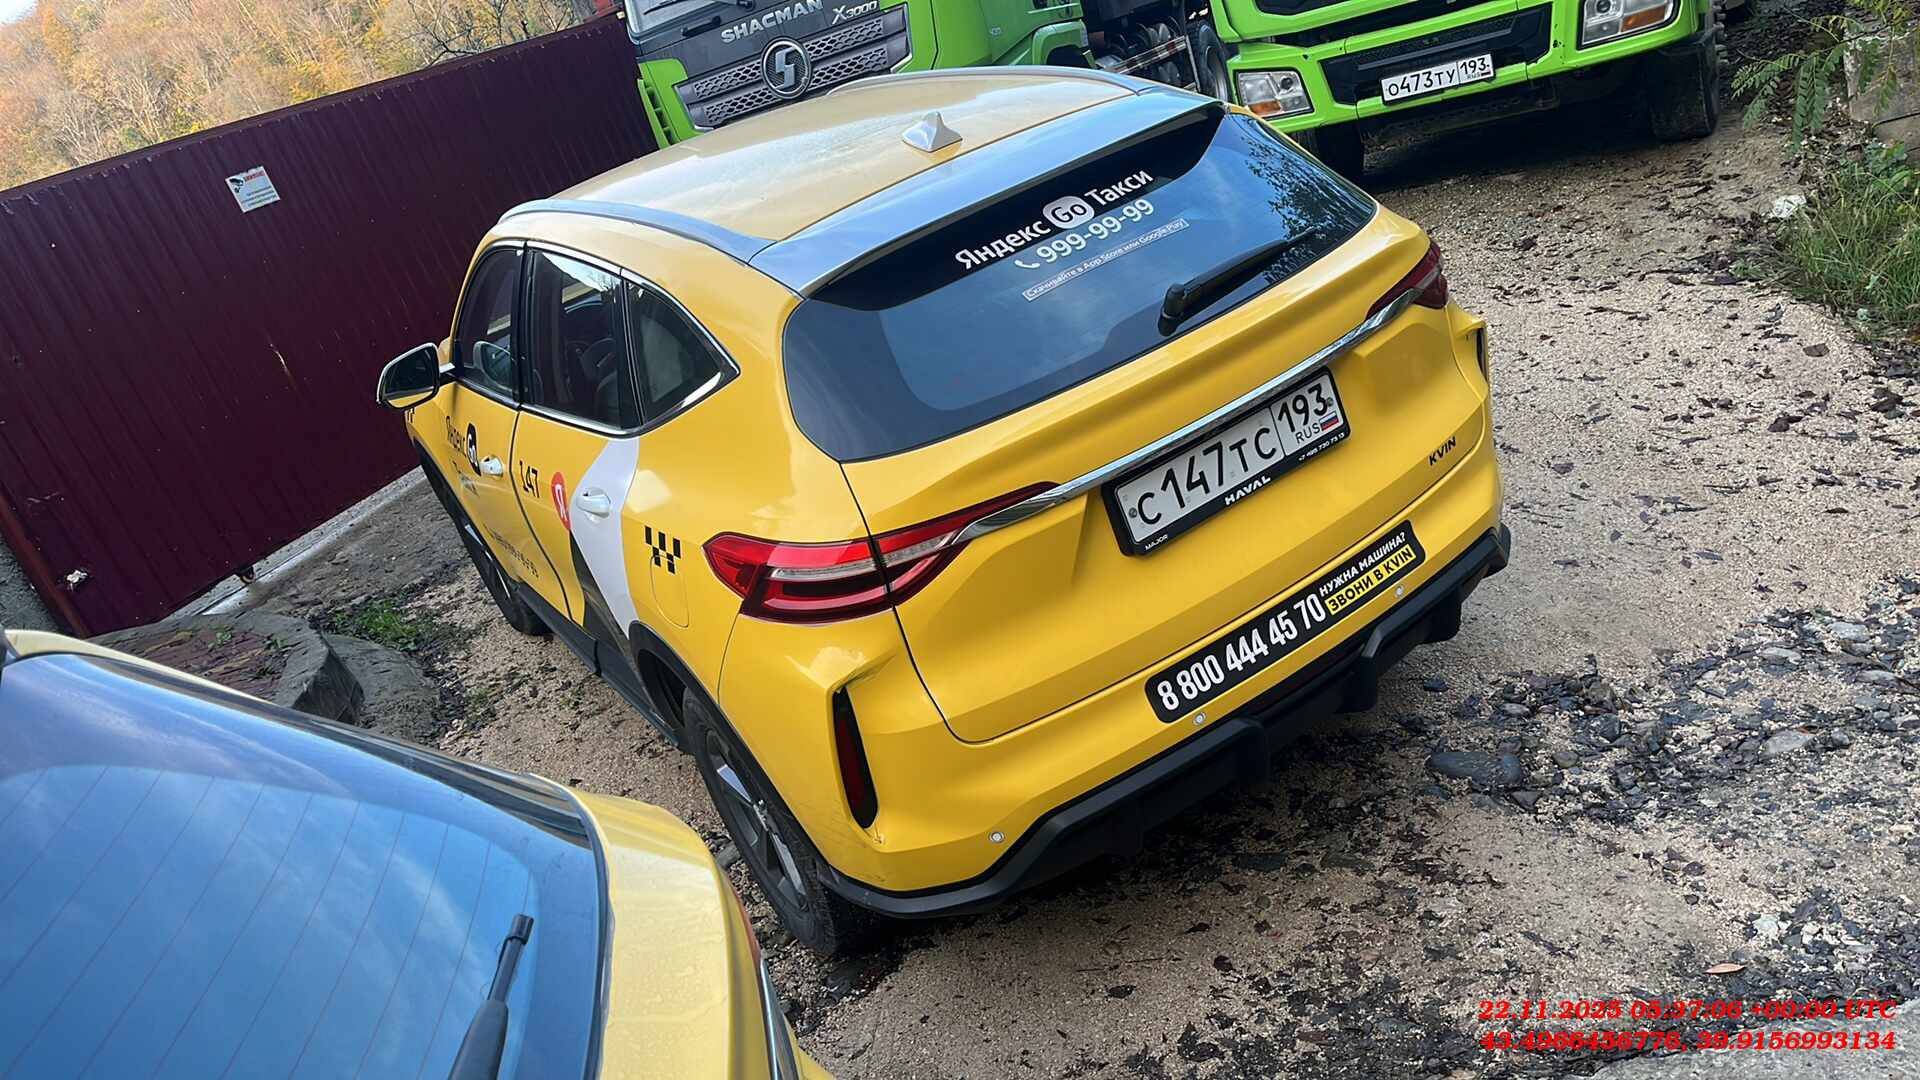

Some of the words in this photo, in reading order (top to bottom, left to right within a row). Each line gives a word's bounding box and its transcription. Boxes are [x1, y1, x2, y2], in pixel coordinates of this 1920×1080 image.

[721, 0, 823, 43] SHACMAN
[832, 0, 878, 25] X3000
[1459, 57, 1486, 75] 193
[955, 219, 1051, 269] Яндекс
[1051, 202, 1088, 223] Go
[1084, 169, 1155, 206] Такси
[1036, 198, 1154, 263] 999-99-99
[1278, 384, 1328, 433] 193
[1296, 422, 1321, 444] RUS
[1429, 436, 1456, 466] KVIN
[519, 460, 540, 499] 147
[1224, 474, 1272, 507] HAVAL
[1319, 566, 1360, 597] НУЖНА
[1358, 531, 1407, 572] МАШИНА?
[1328, 576, 1374, 612] ЗВОНИ
[1373, 568, 1385, 581] В
[1384, 547, 1412, 576] KVIN
[1157, 679, 1180, 711] 8
[1176, 654, 1225, 701] 800
[1225, 627, 1269, 672] 444
[1268, 610, 1298, 647] 45
[1293, 593, 1327, 630] 70
